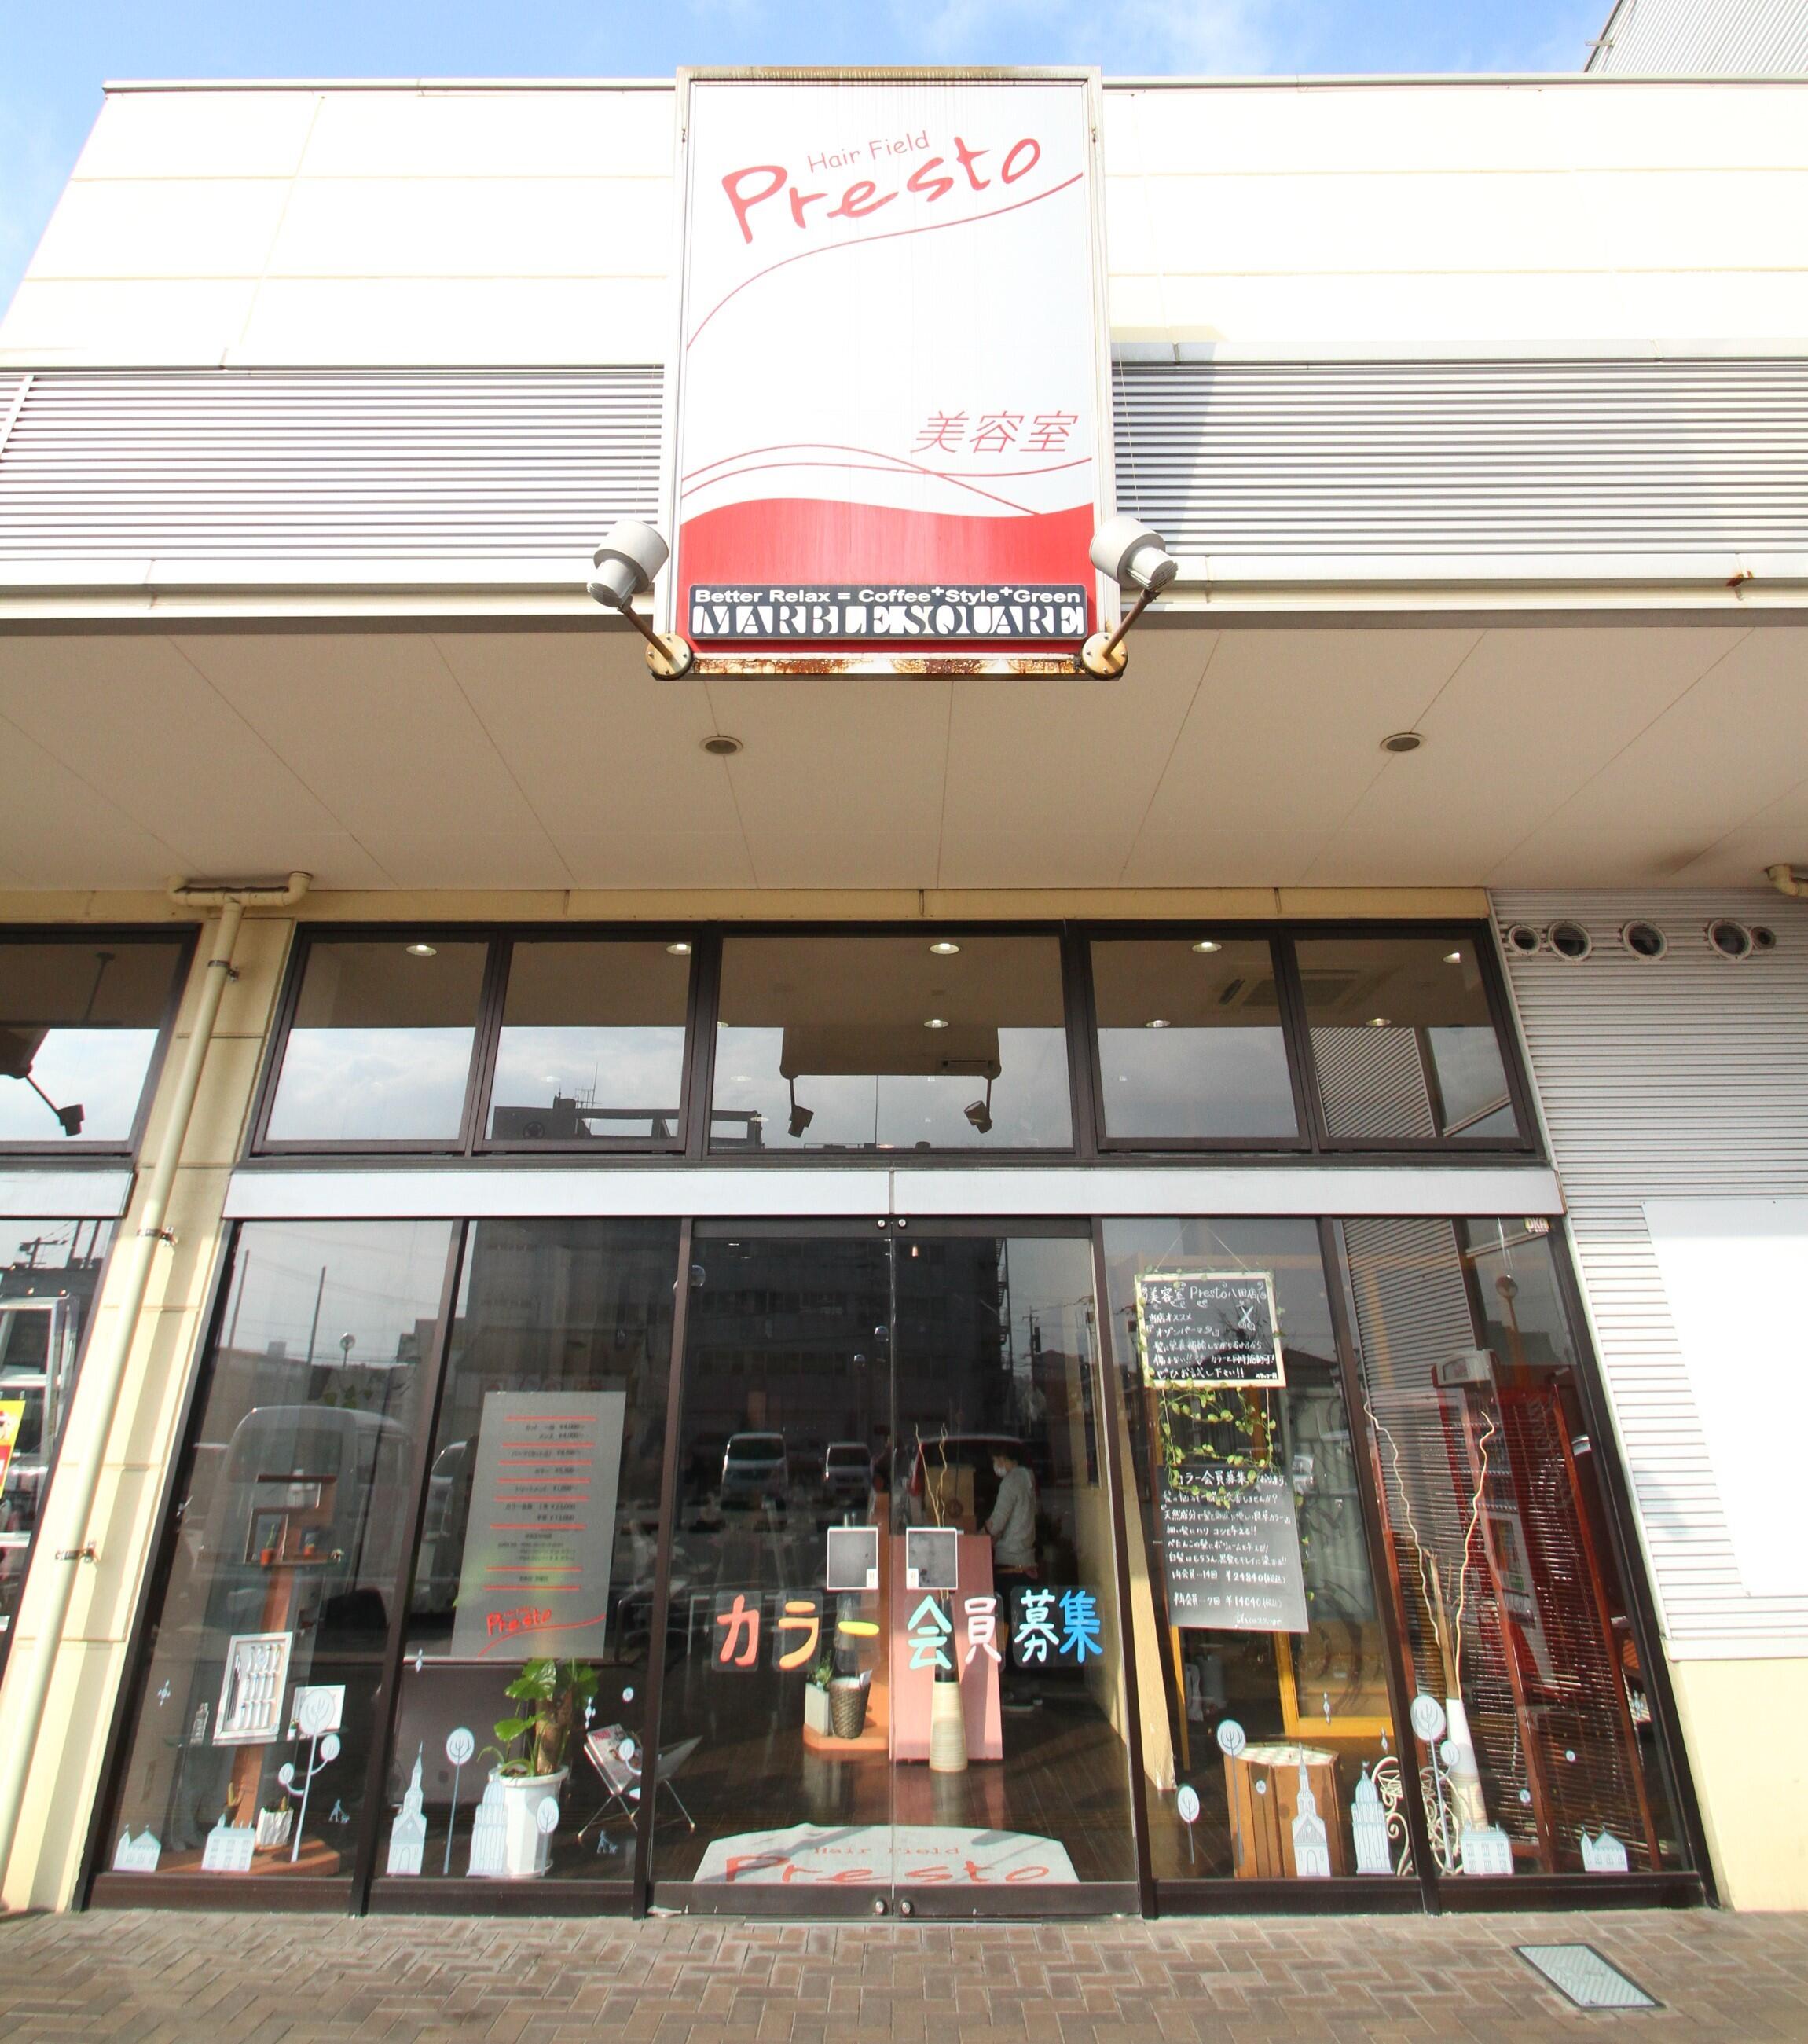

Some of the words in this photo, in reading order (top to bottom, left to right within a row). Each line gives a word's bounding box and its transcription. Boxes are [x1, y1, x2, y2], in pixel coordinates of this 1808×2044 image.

[808, 149, 860, 173] Hair
[868, 130, 930, 160] Field
[721, 136, 1042, 244] Presto
[909, 409, 1079, 453] 美容室
[695, 589, 763, 603] Better
[768, 589, 831, 603] Relax
[726, 1853, 1050, 1883] Presto
[814, 1847, 871, 1855] Hair
